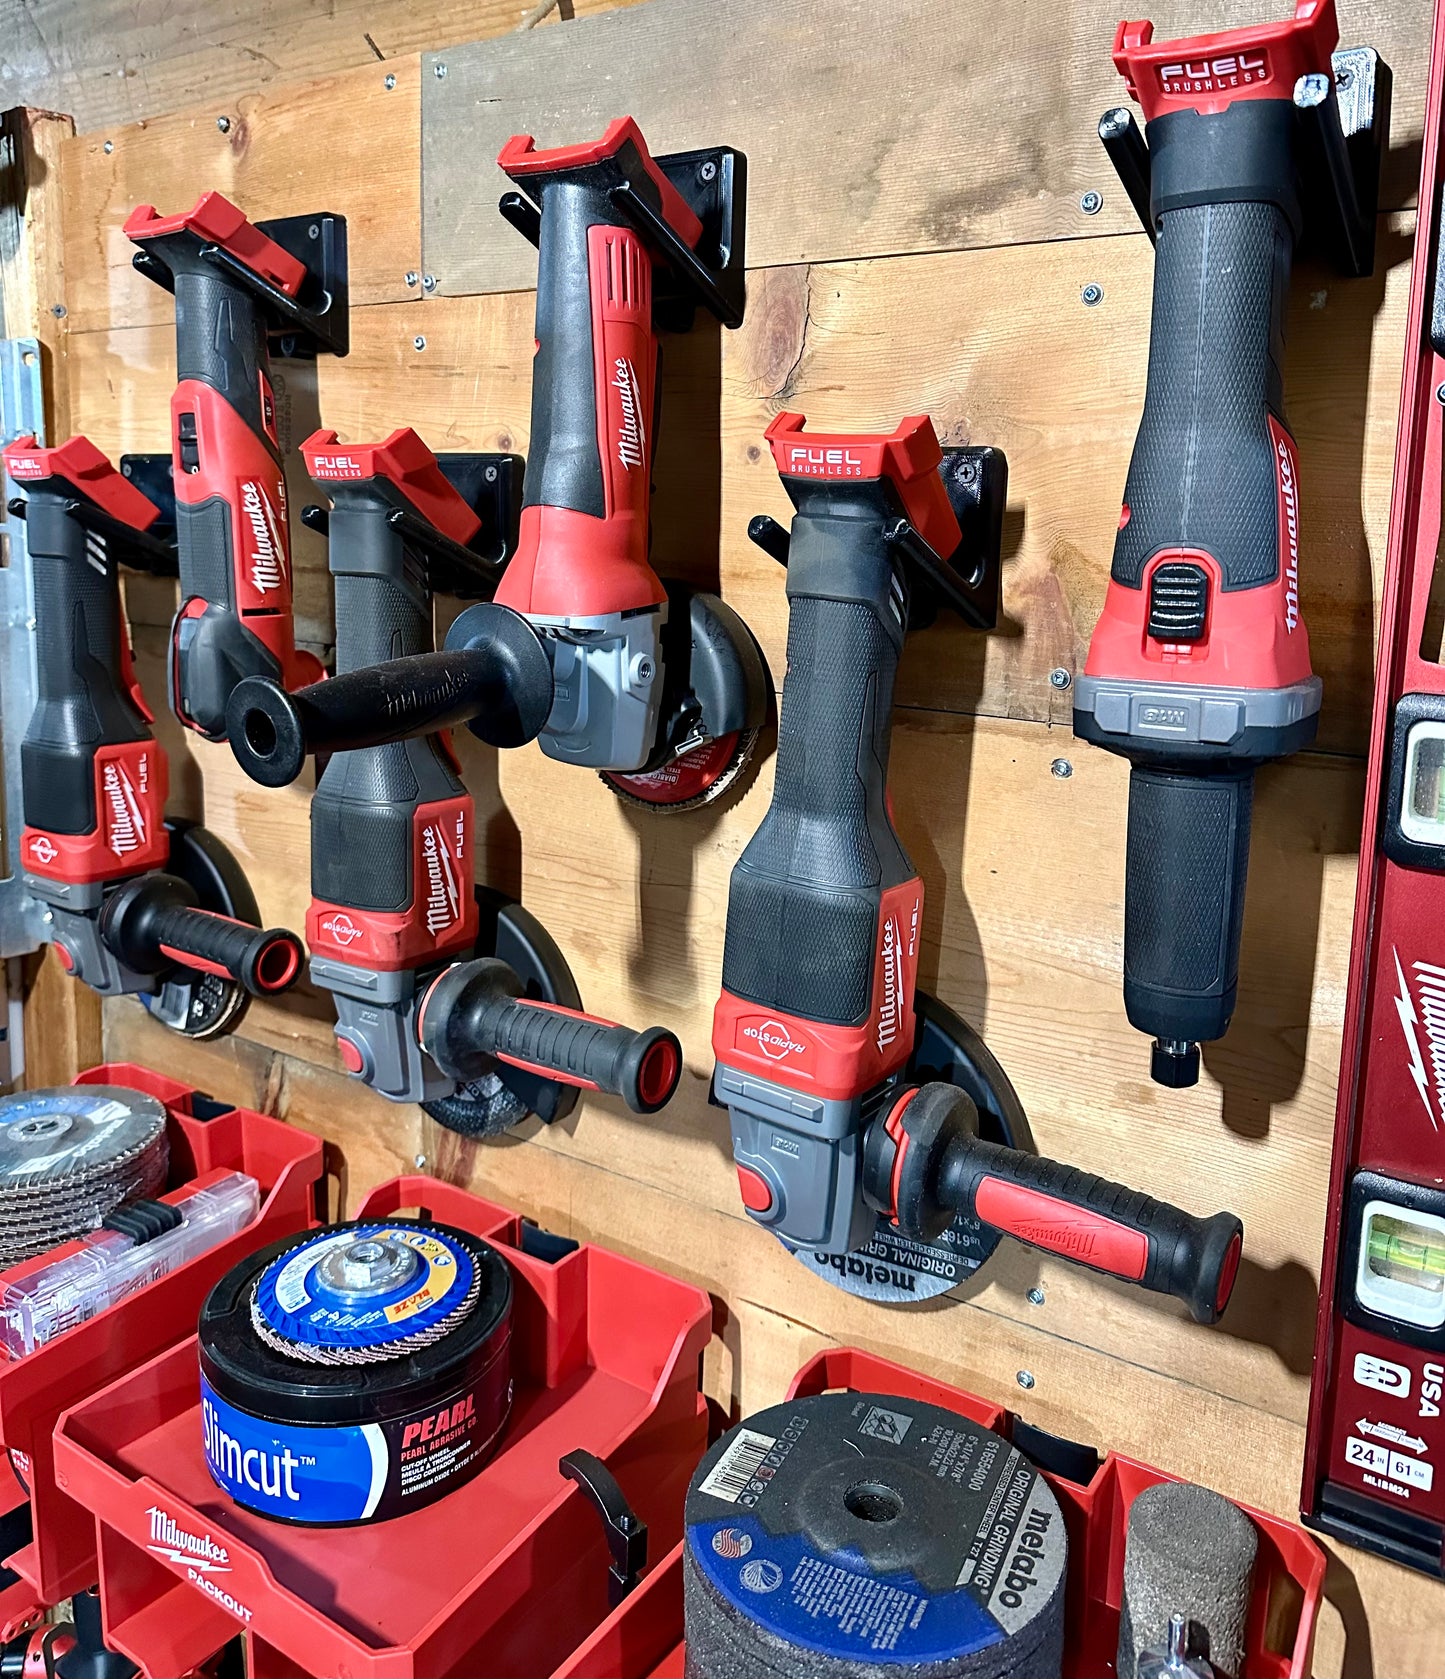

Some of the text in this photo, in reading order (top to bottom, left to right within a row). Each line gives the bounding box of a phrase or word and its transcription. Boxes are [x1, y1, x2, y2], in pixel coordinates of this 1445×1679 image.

[1161, 55, 1264, 81] FUEL
[1163, 69, 1266, 92] BRUSHLESS
[611, 357, 642, 471] Milwaukee
[9, 459, 40, 469] FUEL
[314, 457, 360, 469] FUEL
[791, 448, 861, 465] FUEL
[791, 464, 861, 476] BRUSHLESS
[240, 481, 280, 594] Milwaukee
[1278, 439, 1298, 635] Milwaukee
[138, 752, 148, 794] FUEL
[103, 763, 139, 857] Milwaukee
[456, 811, 464, 859] FUEL
[422, 825, 452, 937] Milwaukee
[322, 921, 363, 938] RAPIDSTOP
[909, 898, 919, 957] FUEL
[876, 917, 896, 1054] Milwaukee
[743, 1027, 806, 1053] RAPIDSTOP
[1010, 1224, 1099, 1257] Milwaukee
[814, 1251, 916, 1292] metabo
[894, 1247, 956, 1278] ORIGINAL
[393, 1288, 431, 1314] BLAZE
[1418, 1362, 1444, 1417] USA
[401, 1393, 476, 1449] PEARL
[401, 1445, 427, 1462] PEARL
[429, 1423, 466, 1452] ABRASIVE
[401, 1447, 451, 1472] CUT-OFF WHEEL
[1351, 1444, 1376, 1465] 24
[401, 1457, 456, 1486] DISCO CORTADOR
[401, 1467, 425, 1479] MEULE
[401, 1478, 434, 1496] ALUMINUM
[434, 1469, 450, 1483] OXIDE
[968, 1441, 1000, 1491] 616554000
[1395, 1461, 1410, 1476] 61
[145, 1506, 230, 1563] Milwaukee
[974, 1470, 1031, 1588] ORIGINAL GRINDING
[999, 1508, 1053, 1609] metabo
[187, 1567, 253, 1622] PACKOUT
